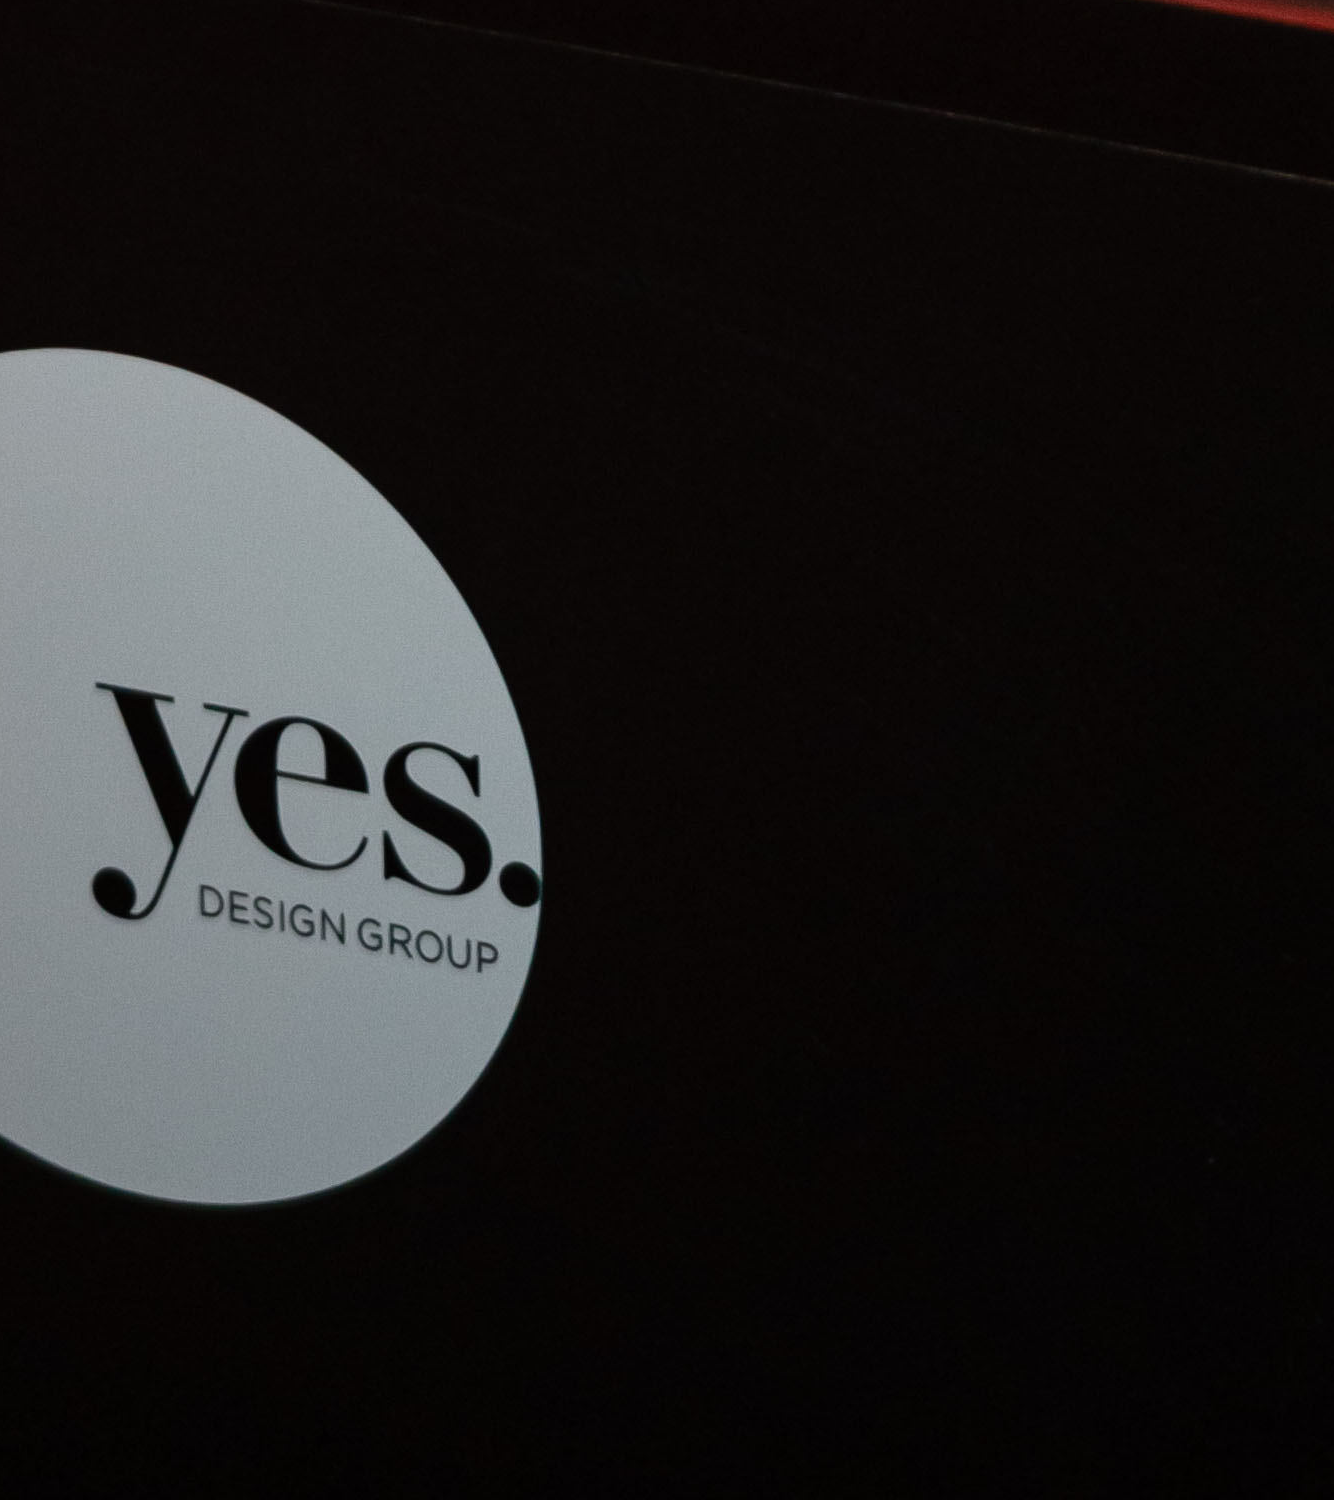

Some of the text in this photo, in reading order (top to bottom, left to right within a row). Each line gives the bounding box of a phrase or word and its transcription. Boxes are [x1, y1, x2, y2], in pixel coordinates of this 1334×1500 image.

[91, 680, 542, 921] yes.
[198, 882, 501, 976] DESIGN GROUP
